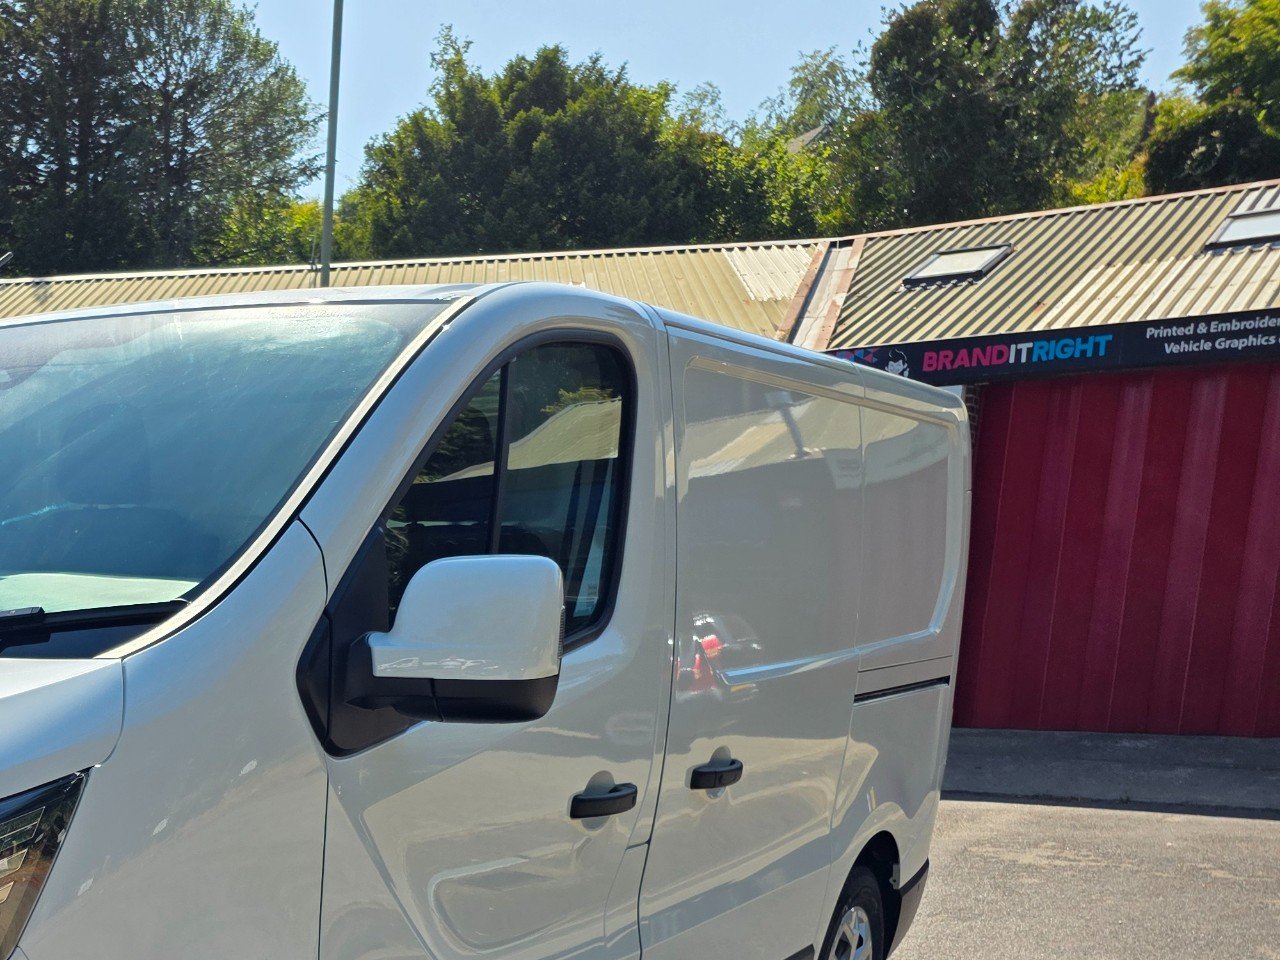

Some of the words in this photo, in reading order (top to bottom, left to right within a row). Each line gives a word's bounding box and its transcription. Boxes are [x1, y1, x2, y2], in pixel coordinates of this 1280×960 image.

[1146, 323, 1195, 339] Printed
[1196, 322, 1208, 335] &
[922, 334, 1113, 373] BRANDITRIGHT
[1164, 339, 1212, 354] Vehicle
[1214, 334, 1276, 350] Graphics
